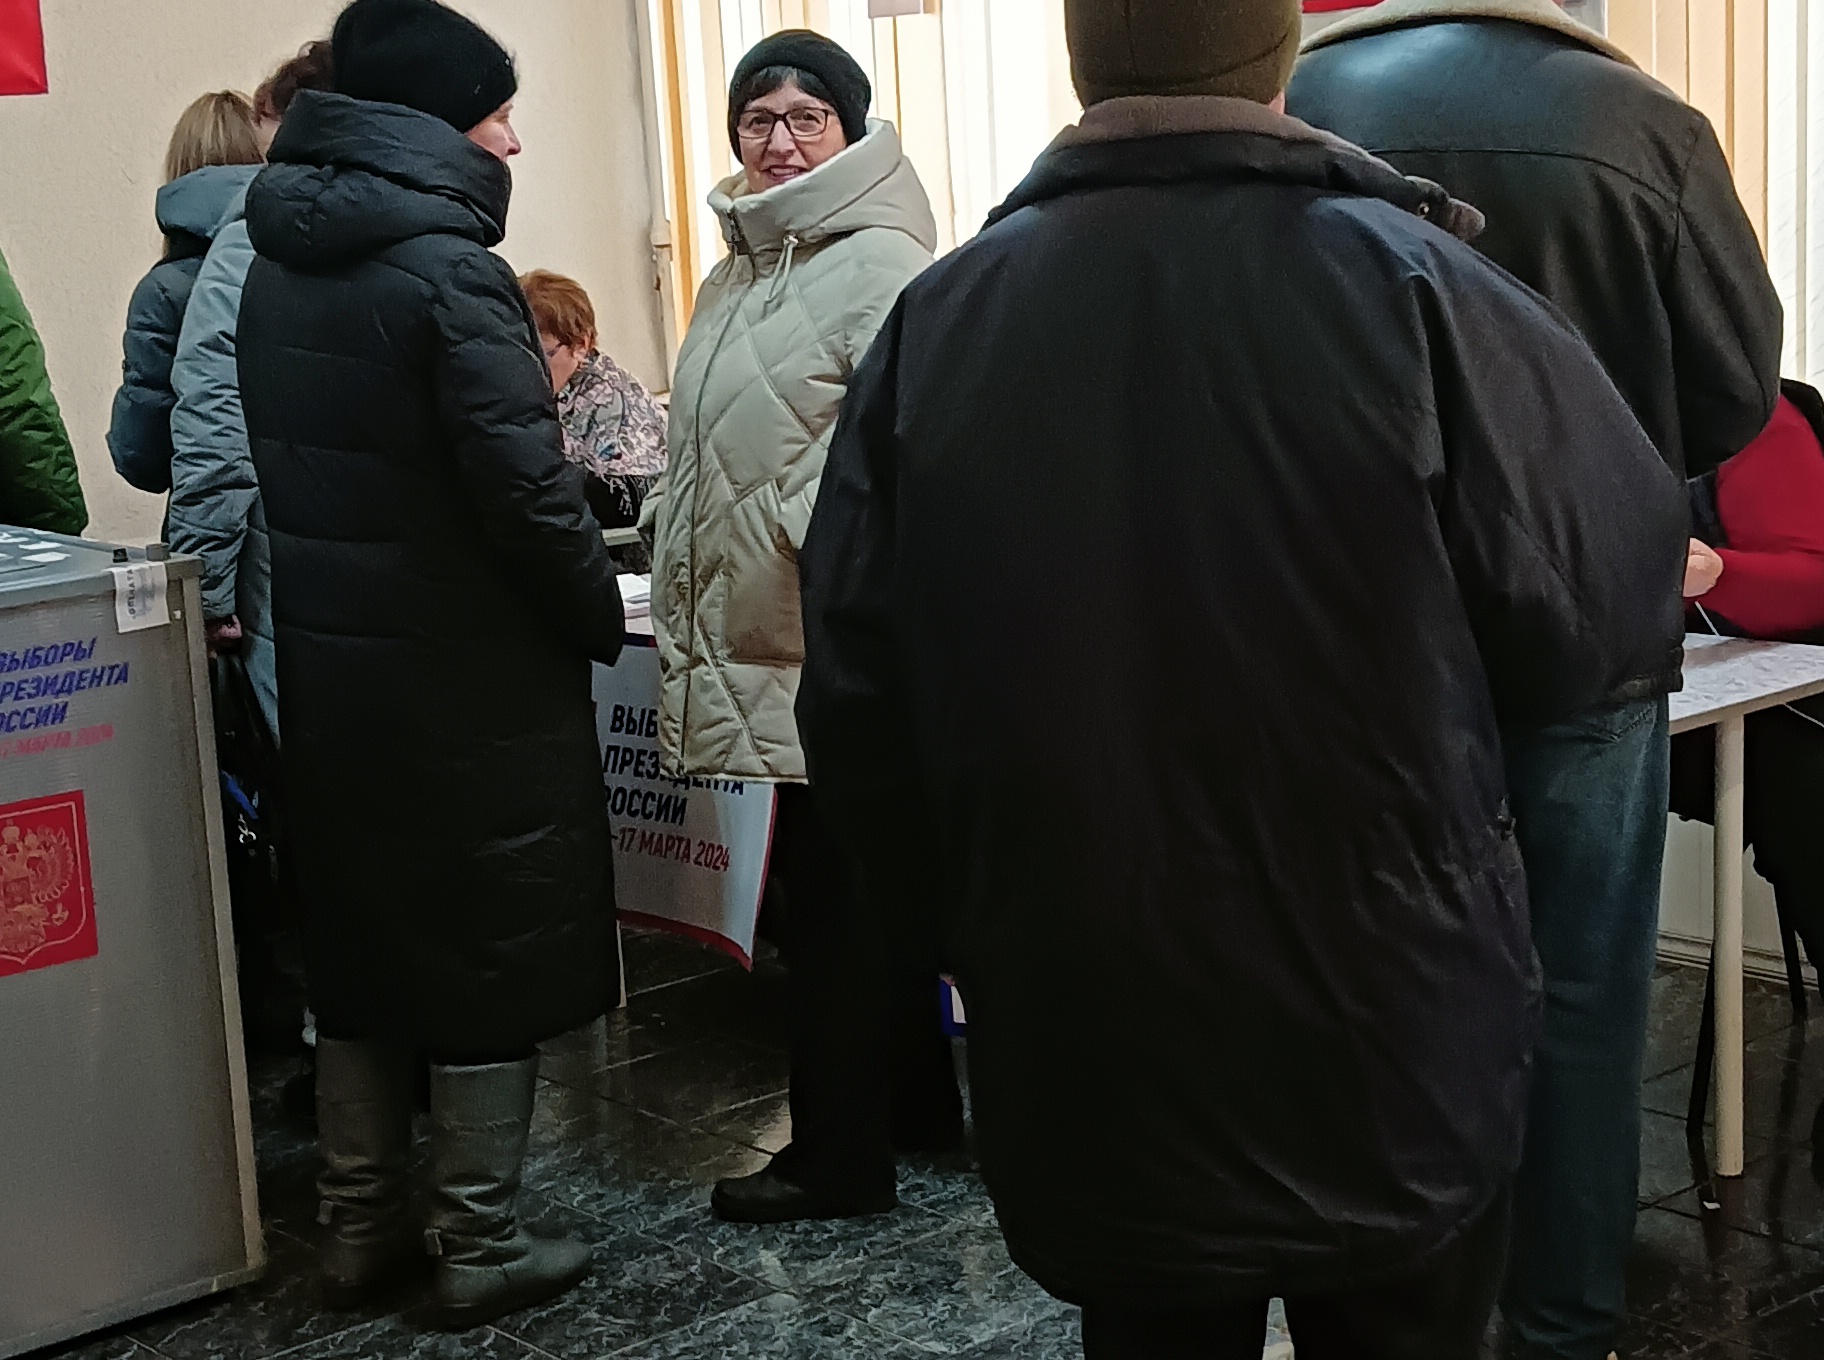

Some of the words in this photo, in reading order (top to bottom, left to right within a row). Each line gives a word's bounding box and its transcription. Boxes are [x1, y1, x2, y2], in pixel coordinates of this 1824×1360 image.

[0, 662, 130, 704] РЕЗИДЕНТА
[0, 701, 69, 734] ССИИ
[610, 704, 658, 738] ВЫБ
[637, 830, 692, 863] МАРТА
[693, 840, 730, 872] 2024
